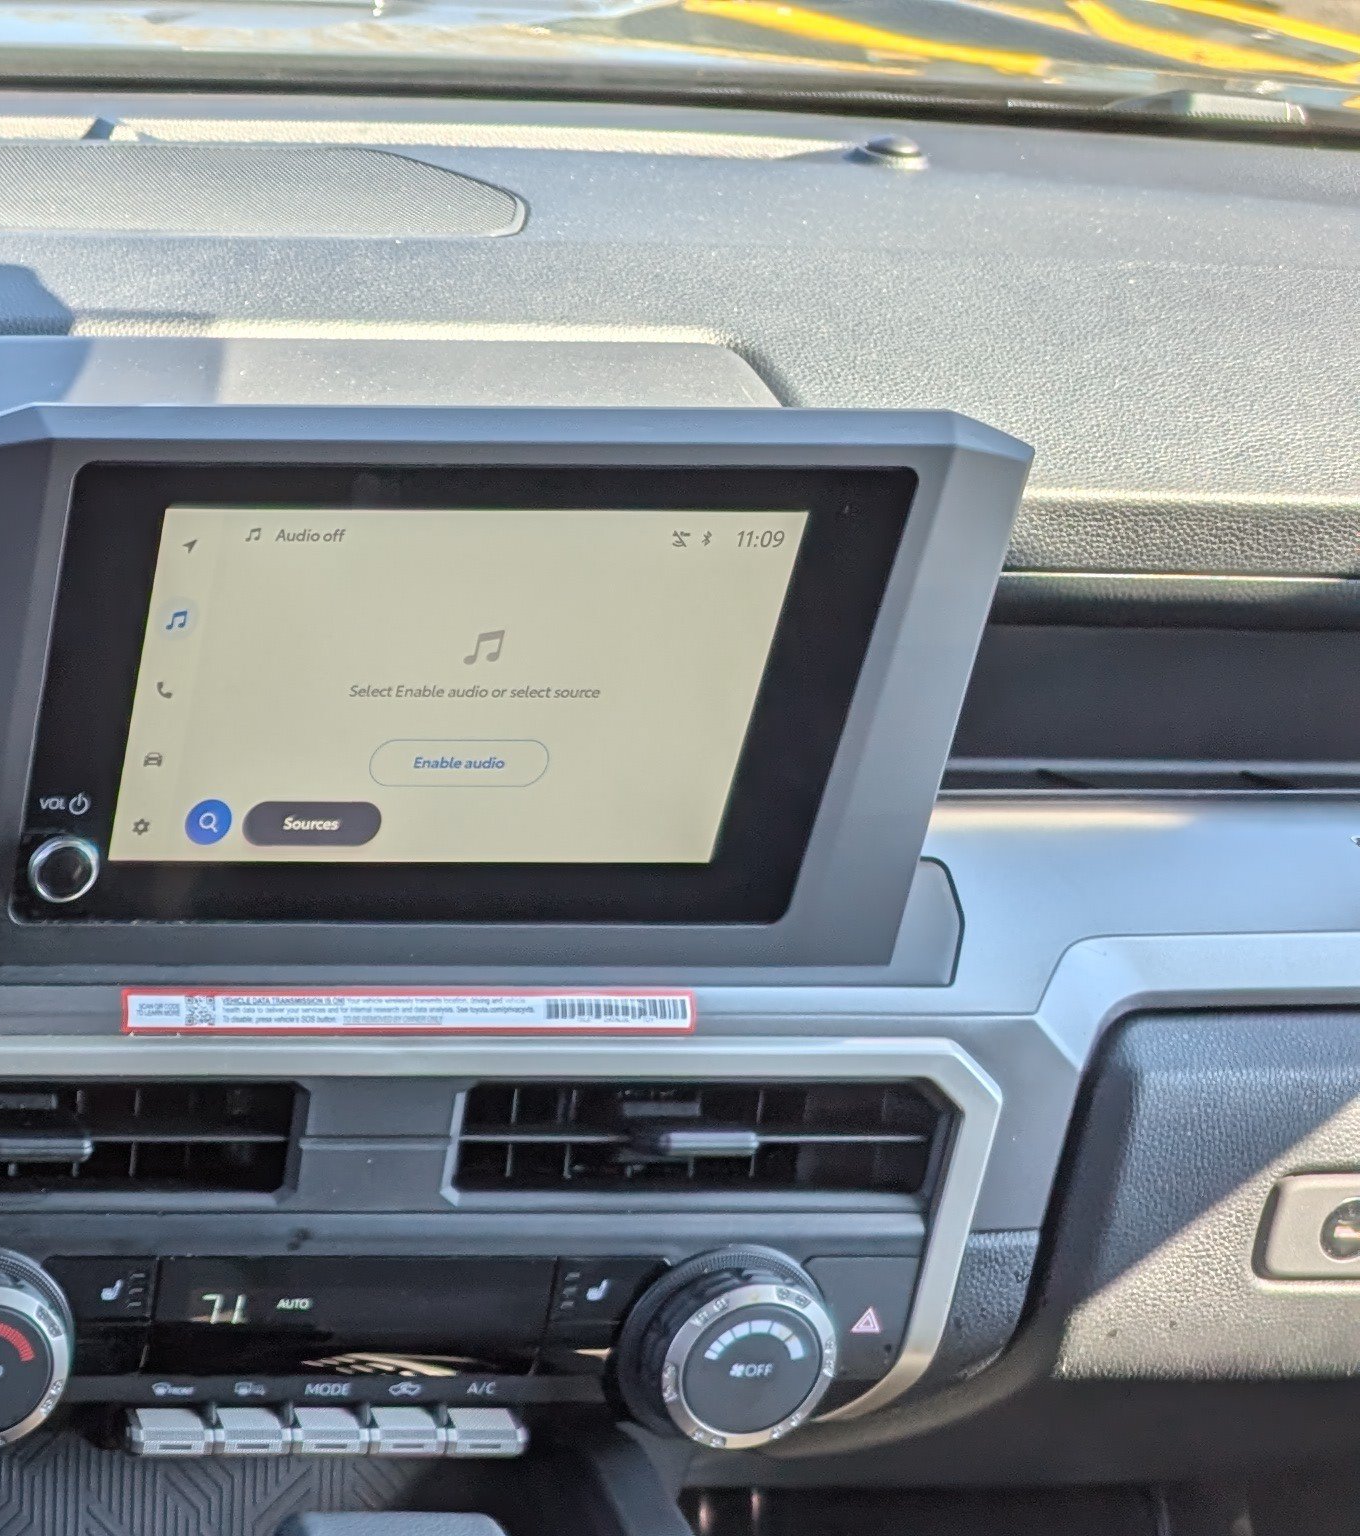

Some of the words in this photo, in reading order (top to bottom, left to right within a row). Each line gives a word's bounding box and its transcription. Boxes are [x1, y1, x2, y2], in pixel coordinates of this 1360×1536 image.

[276, 527, 320, 544] Audio
[323, 527, 346, 544] off
[737, 531, 786, 549] 11:09
[349, 684, 391, 700] Select
[395, 684, 445, 700] Enable
[448, 684, 488, 700] audio
[492, 687, 507, 700] or
[510, 684, 551, 700] select
[554, 687, 601, 700] source
[413, 755, 461, 771] Enable
[464, 755, 505, 771] audio
[283, 816, 340, 832] Sources
[202, 1294, 248, 1324] 71
[277, 1299, 312, 1311] AUTO
[746, 1363, 774, 1378] OFF
[305, 1383, 351, 1396] MODE
[467, 1382, 497, 1396] A/C
